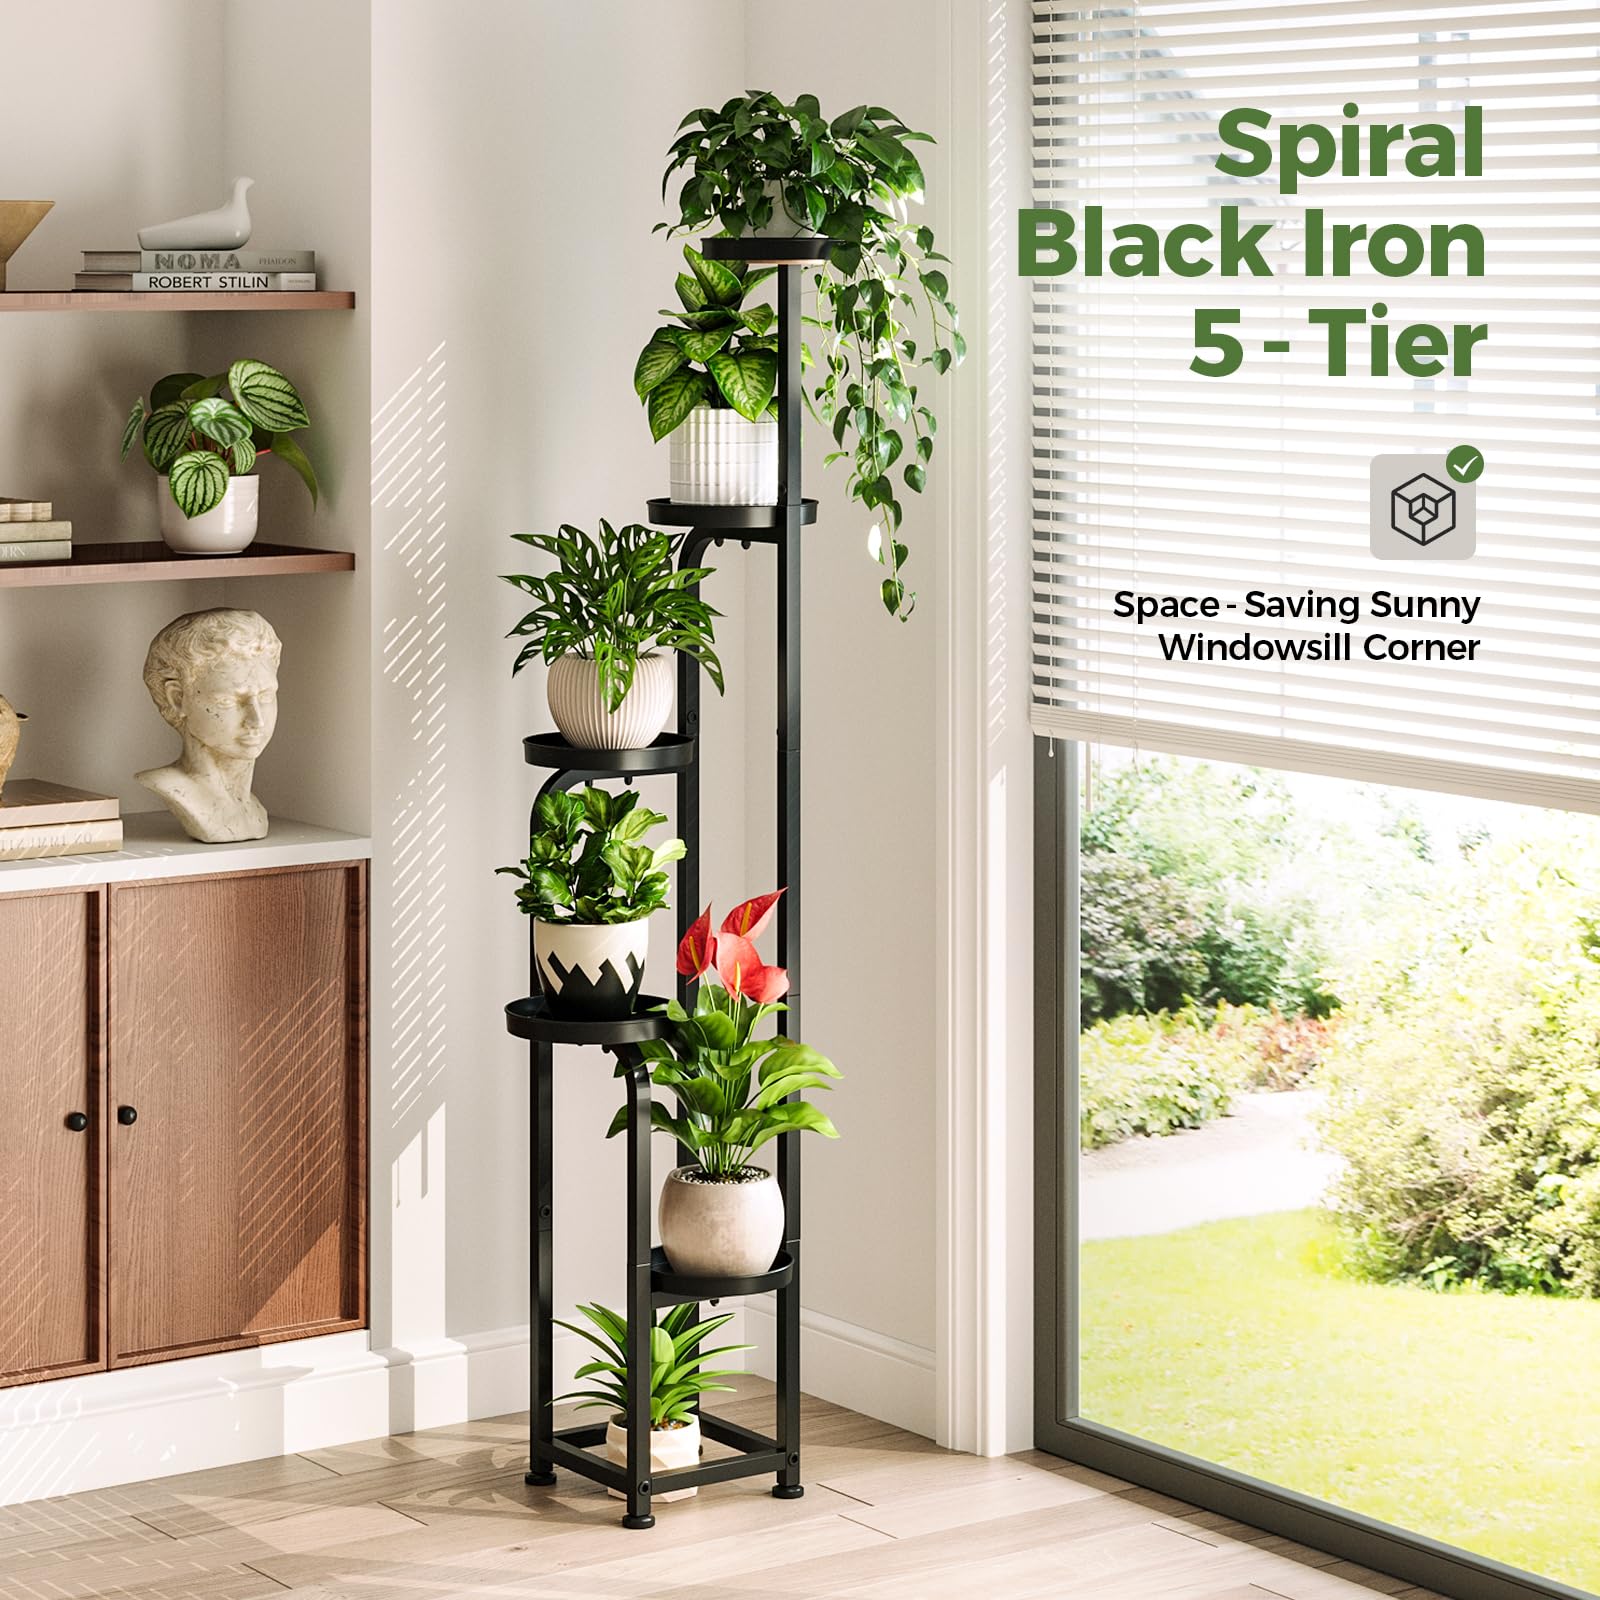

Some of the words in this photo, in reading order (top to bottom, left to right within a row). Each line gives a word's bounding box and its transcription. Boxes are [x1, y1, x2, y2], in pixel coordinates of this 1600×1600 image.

[154, 253, 242, 270] NOMA
[149, 276, 212, 288] ROBERT
[218, 276, 269, 288] STILIN
